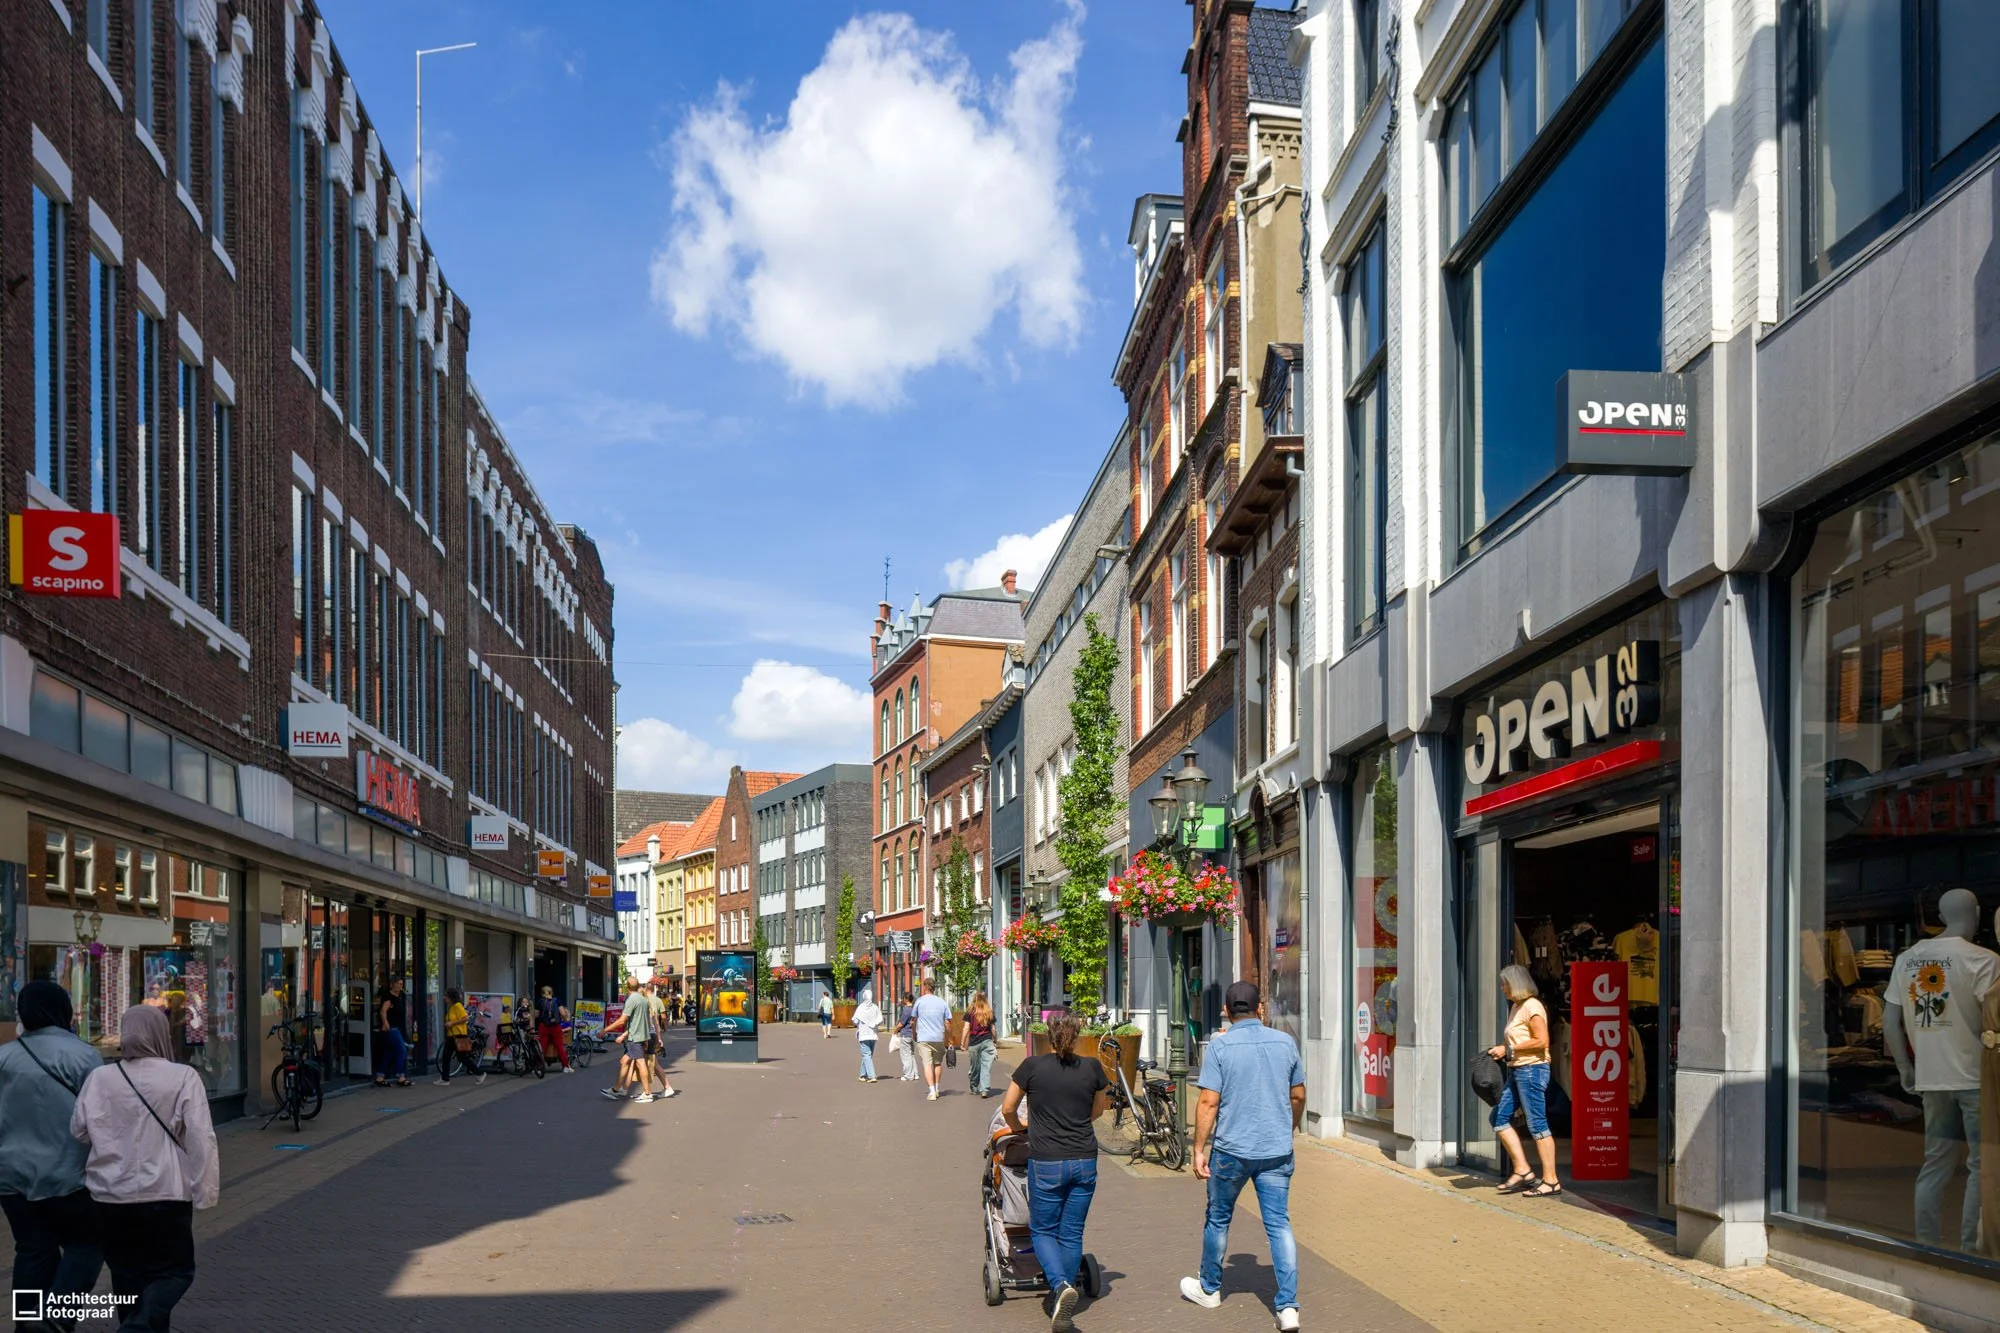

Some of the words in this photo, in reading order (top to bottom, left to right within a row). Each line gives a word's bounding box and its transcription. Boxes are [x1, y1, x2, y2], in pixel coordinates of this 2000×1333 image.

[48, 526, 88, 571] S
[32, 576, 104, 592] scapino
[293, 730, 341, 744] HEMA
[366, 751, 421, 826] HEMA
[474, 833, 505, 842] HEMA
[1633, 844, 1650, 857] Sale
[1584, 974, 1621, 1082] Sale
[1359, 1045, 1391, 1078] Sale
